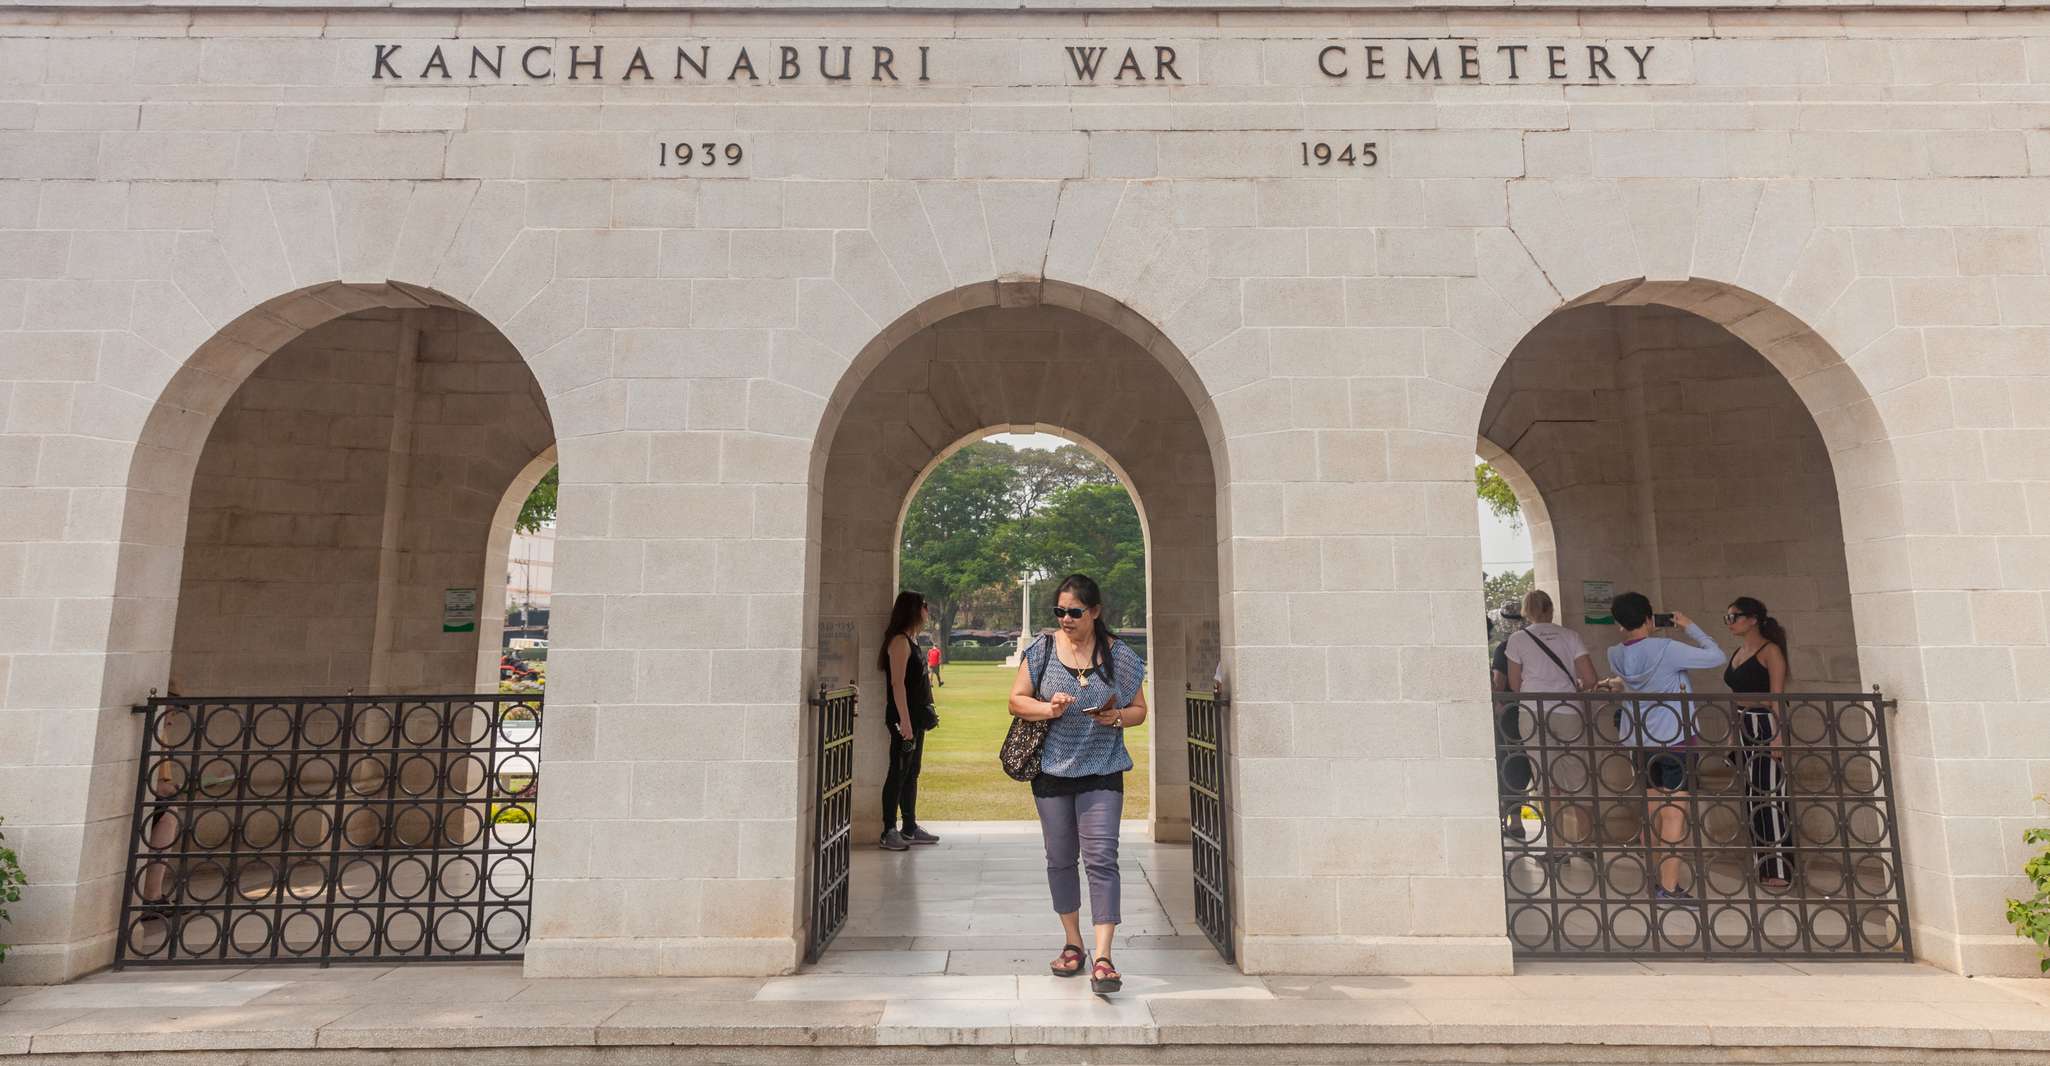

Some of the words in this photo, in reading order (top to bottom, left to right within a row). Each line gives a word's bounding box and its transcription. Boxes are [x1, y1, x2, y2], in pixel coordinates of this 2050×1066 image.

[371, 44, 931, 82] KANCHANABURI
[1064, 45, 1183, 81] WAR
[1317, 44, 1656, 81] CEMETERY
[658, 141, 744, 168] 1939
[1300, 141, 1379, 168] 1945
